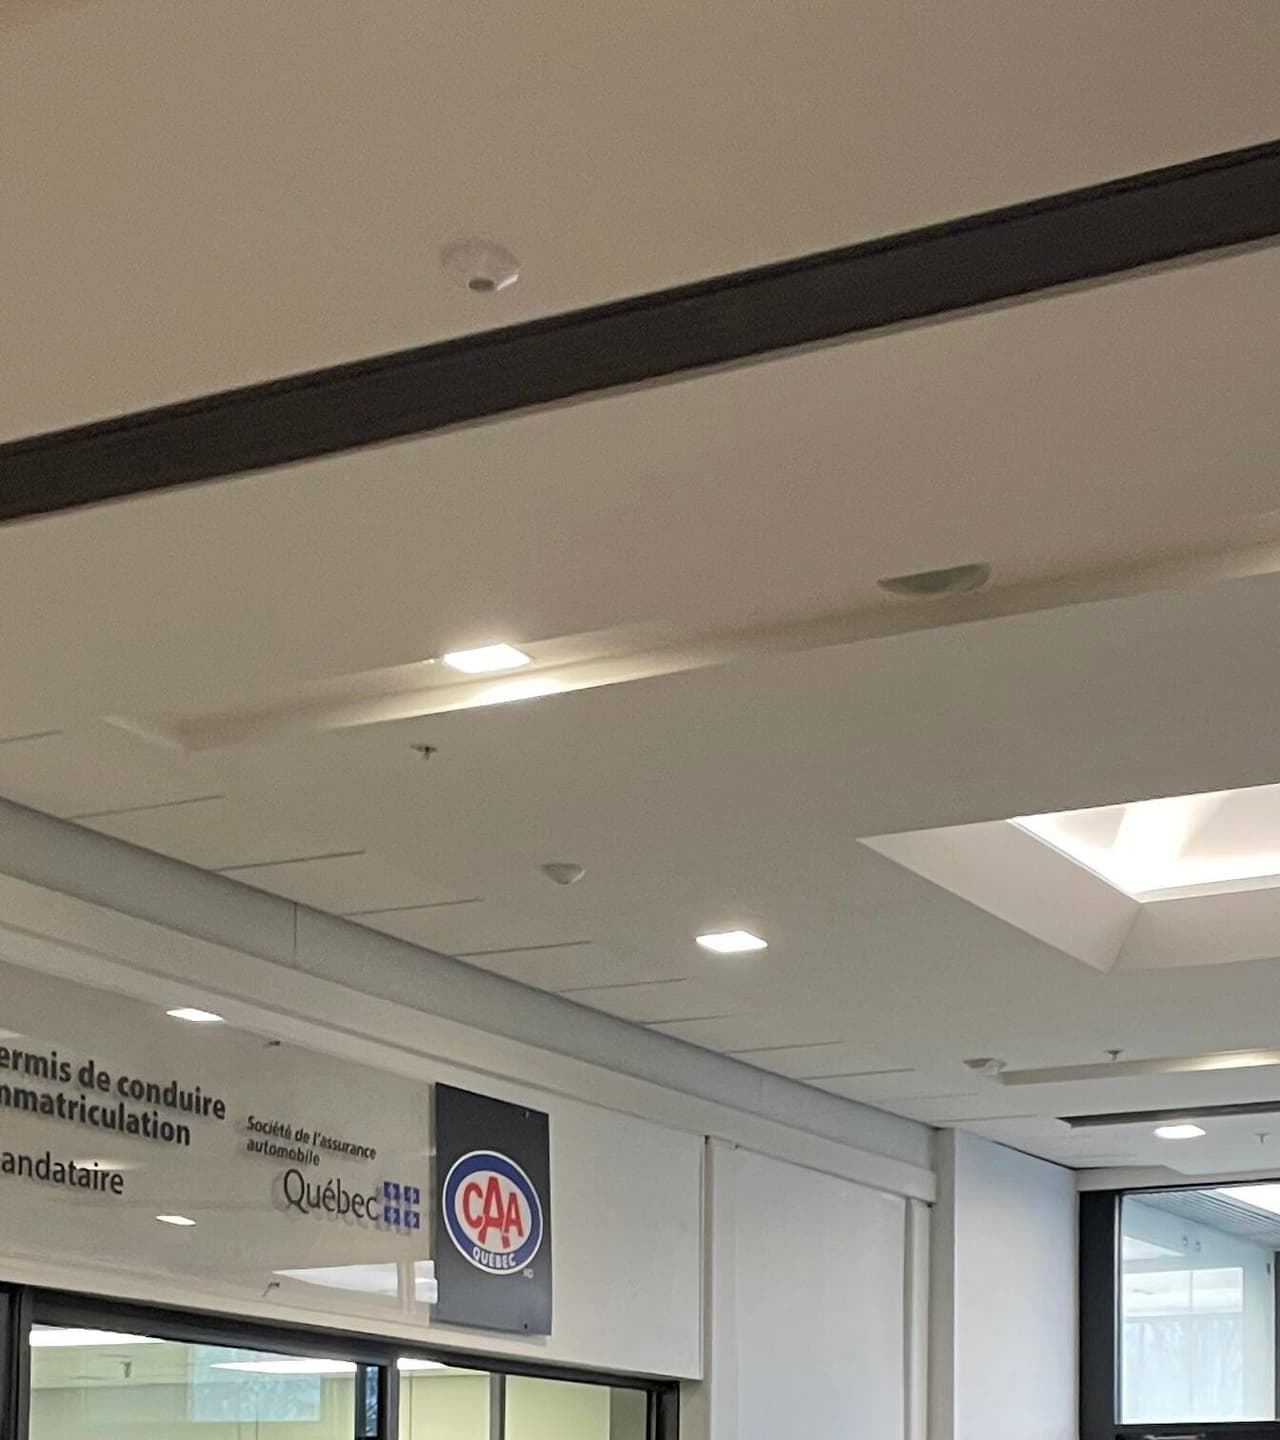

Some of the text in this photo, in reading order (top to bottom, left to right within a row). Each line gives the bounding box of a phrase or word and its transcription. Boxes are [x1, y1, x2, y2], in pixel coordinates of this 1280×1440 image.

[78, 1060, 111, 1092] de
[117, 1075, 226, 1120] conduire
[246, 1115, 292, 1141] Société
[294, 1128, 310, 1144] de
[246, 1138, 320, 1166] automobile
[283, 1168, 380, 1221] Québec
[462, 1176, 524, 1249] CAA
[472, 1246, 517, 1269] QUÉBEC
